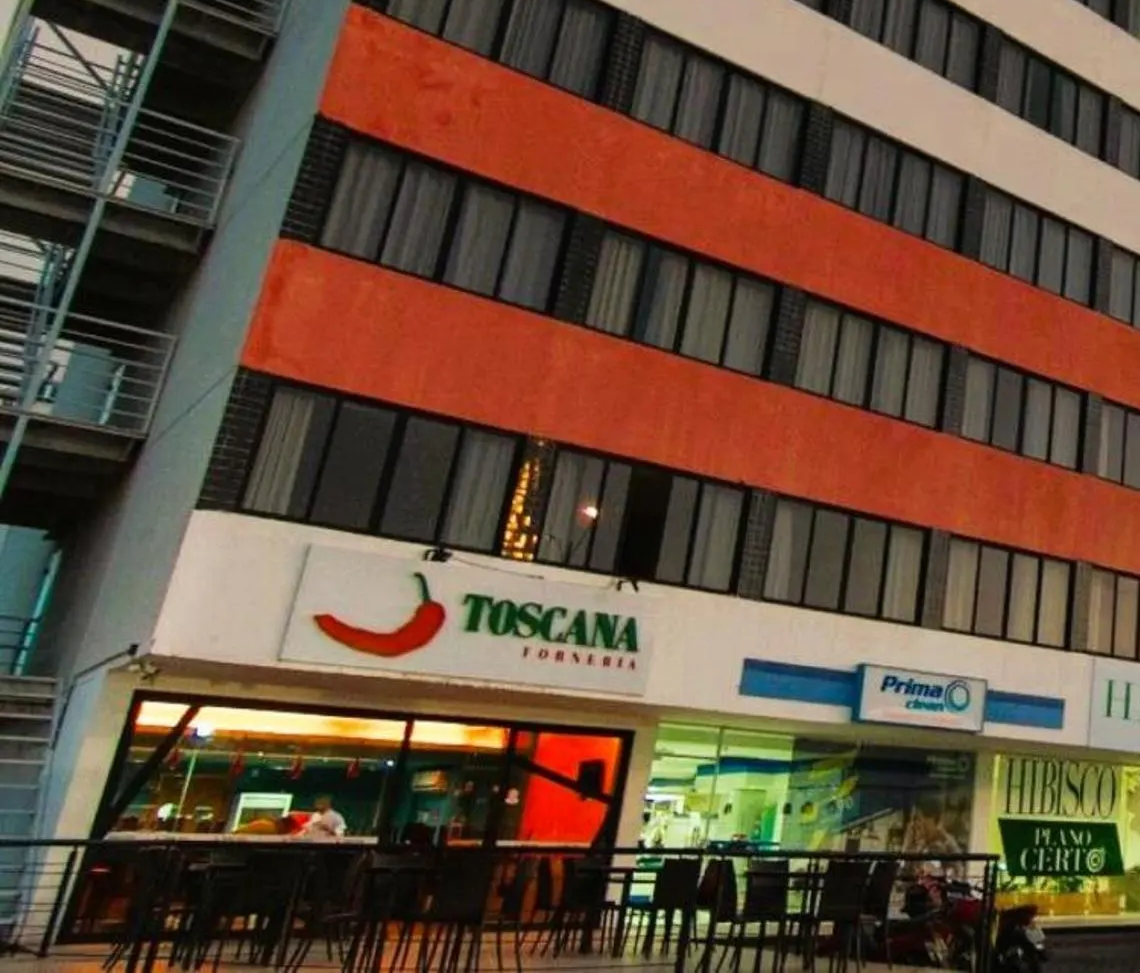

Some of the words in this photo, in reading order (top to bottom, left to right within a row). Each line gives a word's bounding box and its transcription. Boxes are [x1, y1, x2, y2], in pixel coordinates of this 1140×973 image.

[462, 593, 639, 653] TOSCANA
[522, 646, 637, 670] FORNERIA
[880, 675, 944, 698] Prima
[1004, 757, 1116, 818] HIBISCO
[1035, 827, 1093, 846] PLANO
